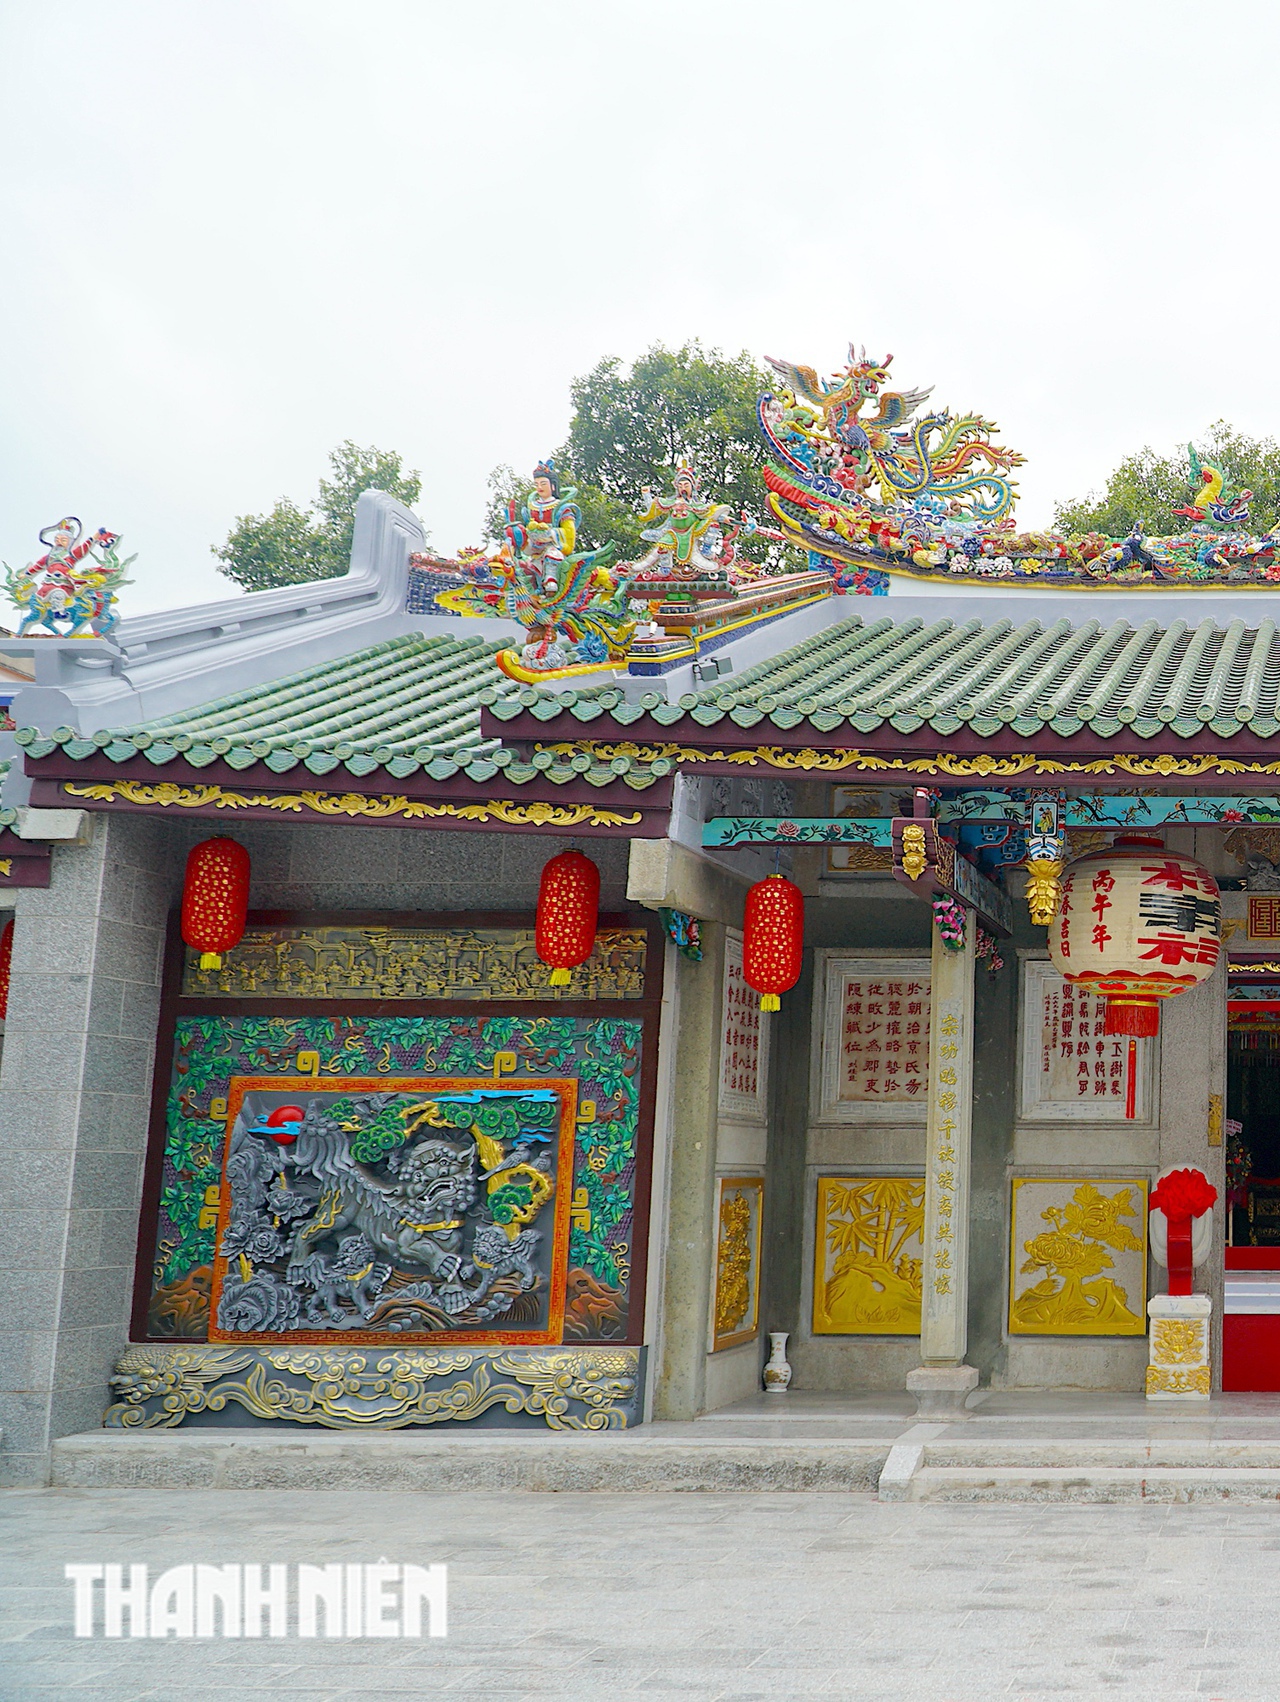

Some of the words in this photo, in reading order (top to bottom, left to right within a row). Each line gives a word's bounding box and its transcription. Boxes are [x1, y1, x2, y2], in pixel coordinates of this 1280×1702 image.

[1059, 872, 1077, 958] 孟春吉日
[1091, 869, 1116, 953] 丙午年
